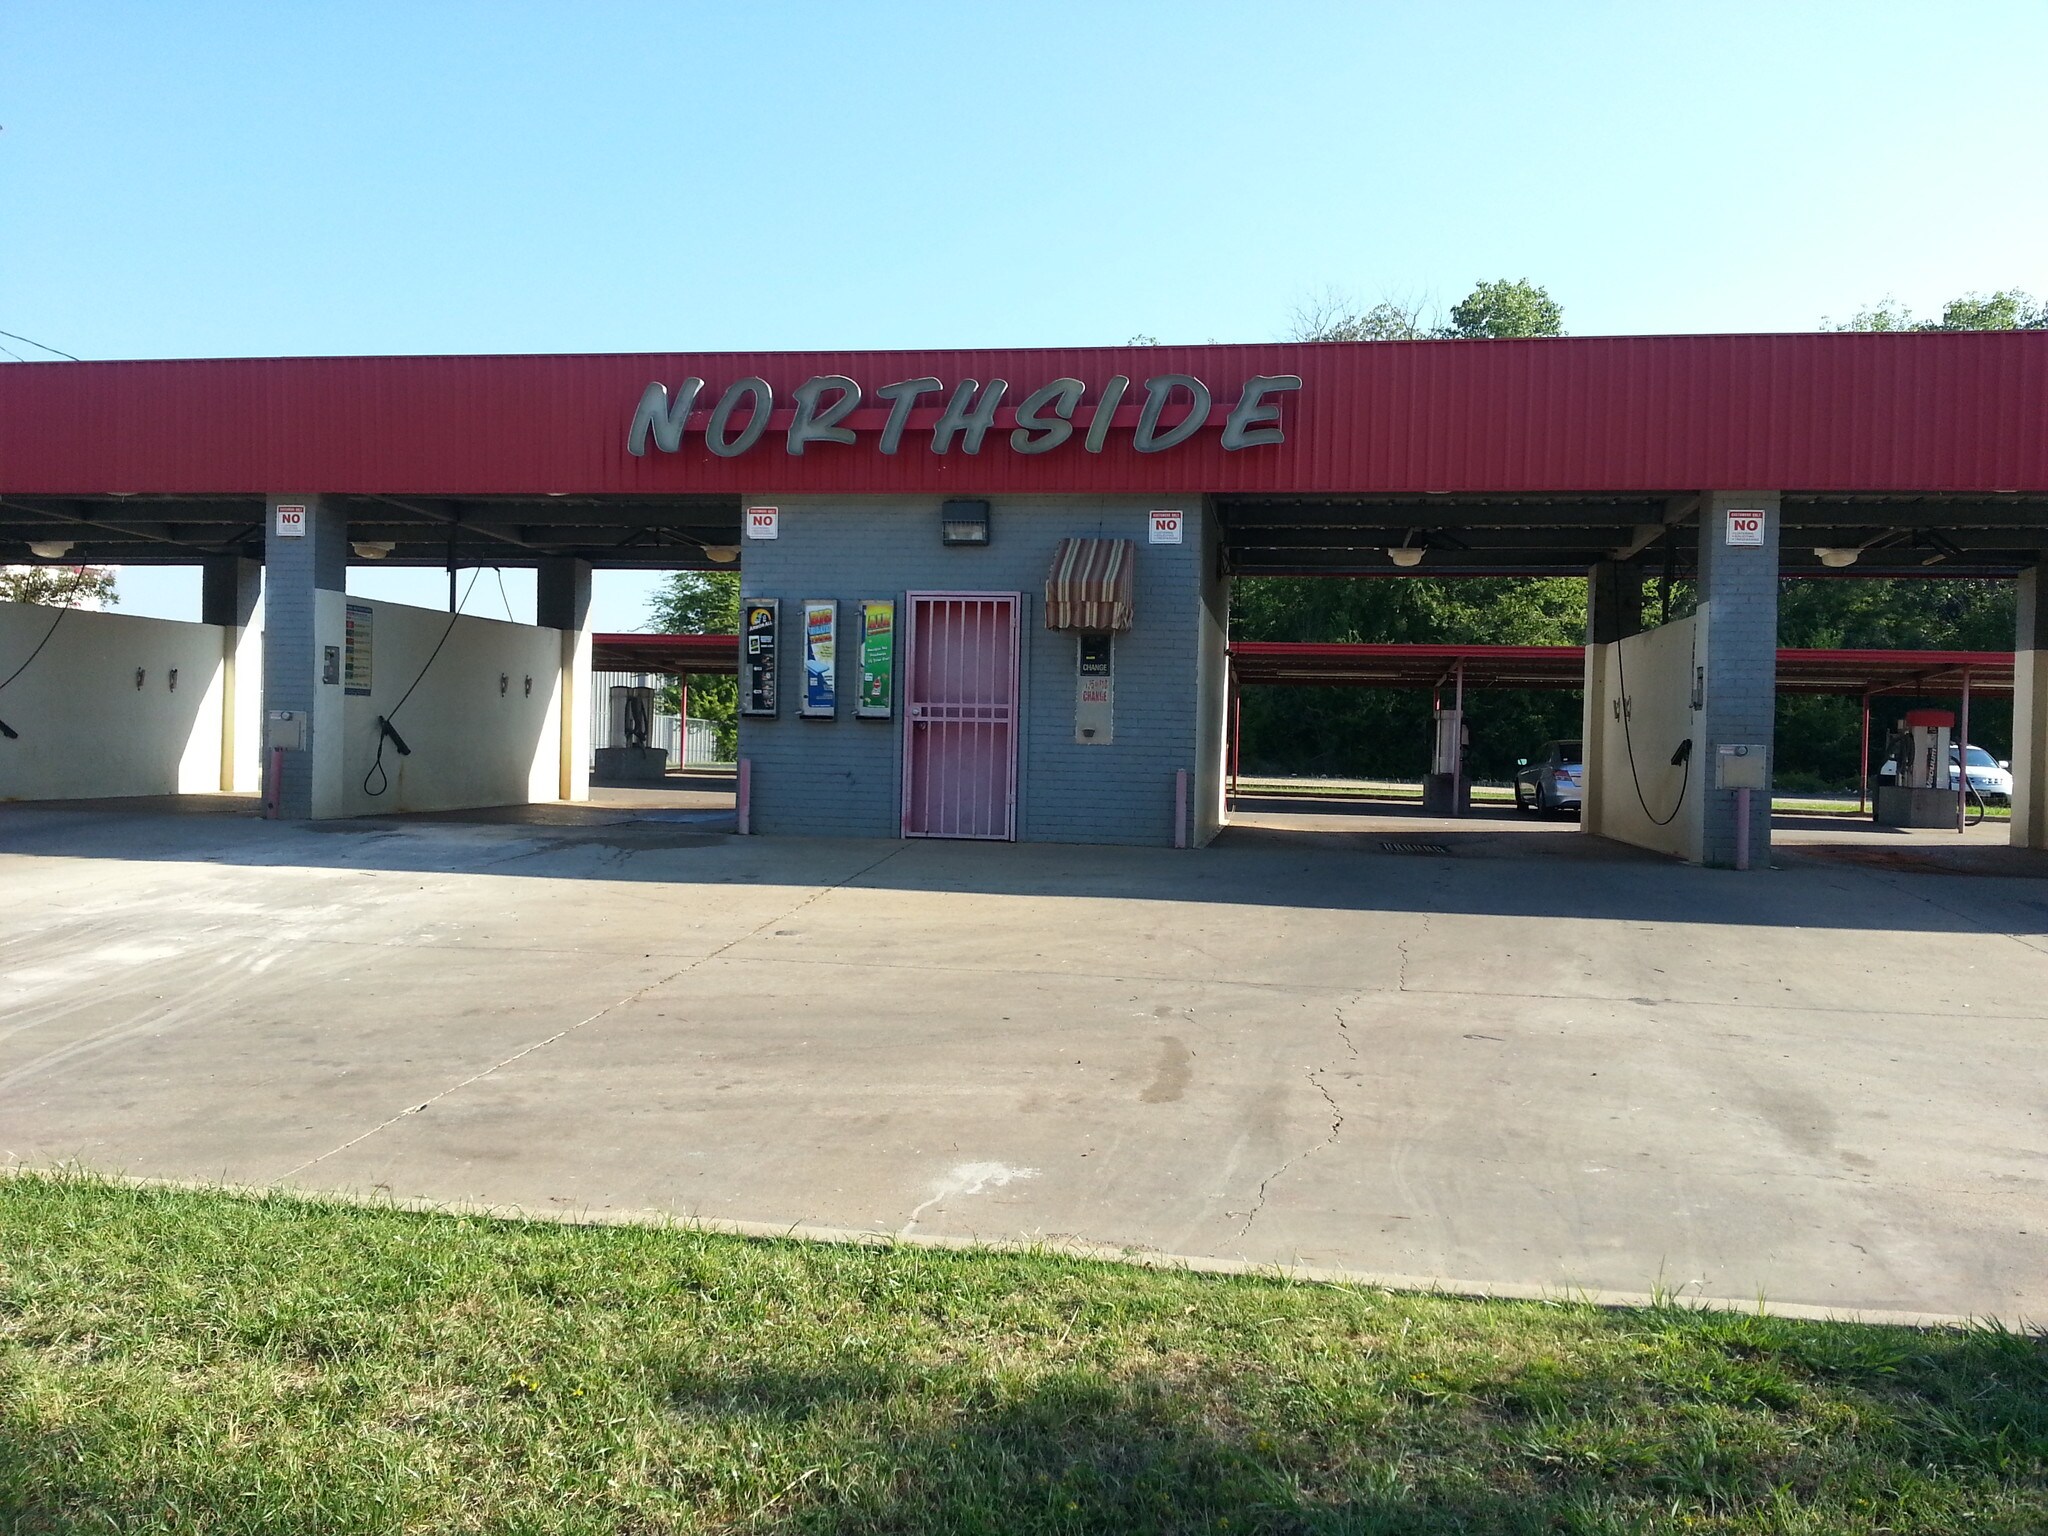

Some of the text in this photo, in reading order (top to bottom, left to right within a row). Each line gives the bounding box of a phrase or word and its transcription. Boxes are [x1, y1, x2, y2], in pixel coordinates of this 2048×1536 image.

[627, 373, 1303, 457] NORTHSIDE
[282, 514, 301, 523] NO
[753, 516, 773, 526] NO
[1156, 520, 1177, 530] NO
[1734, 520, 1758, 531] NO
[1082, 663, 1108, 671] CHANGE
[1082, 691, 1107, 702] CHANGE
[1926, 748, 1937, 789] Vacuum
